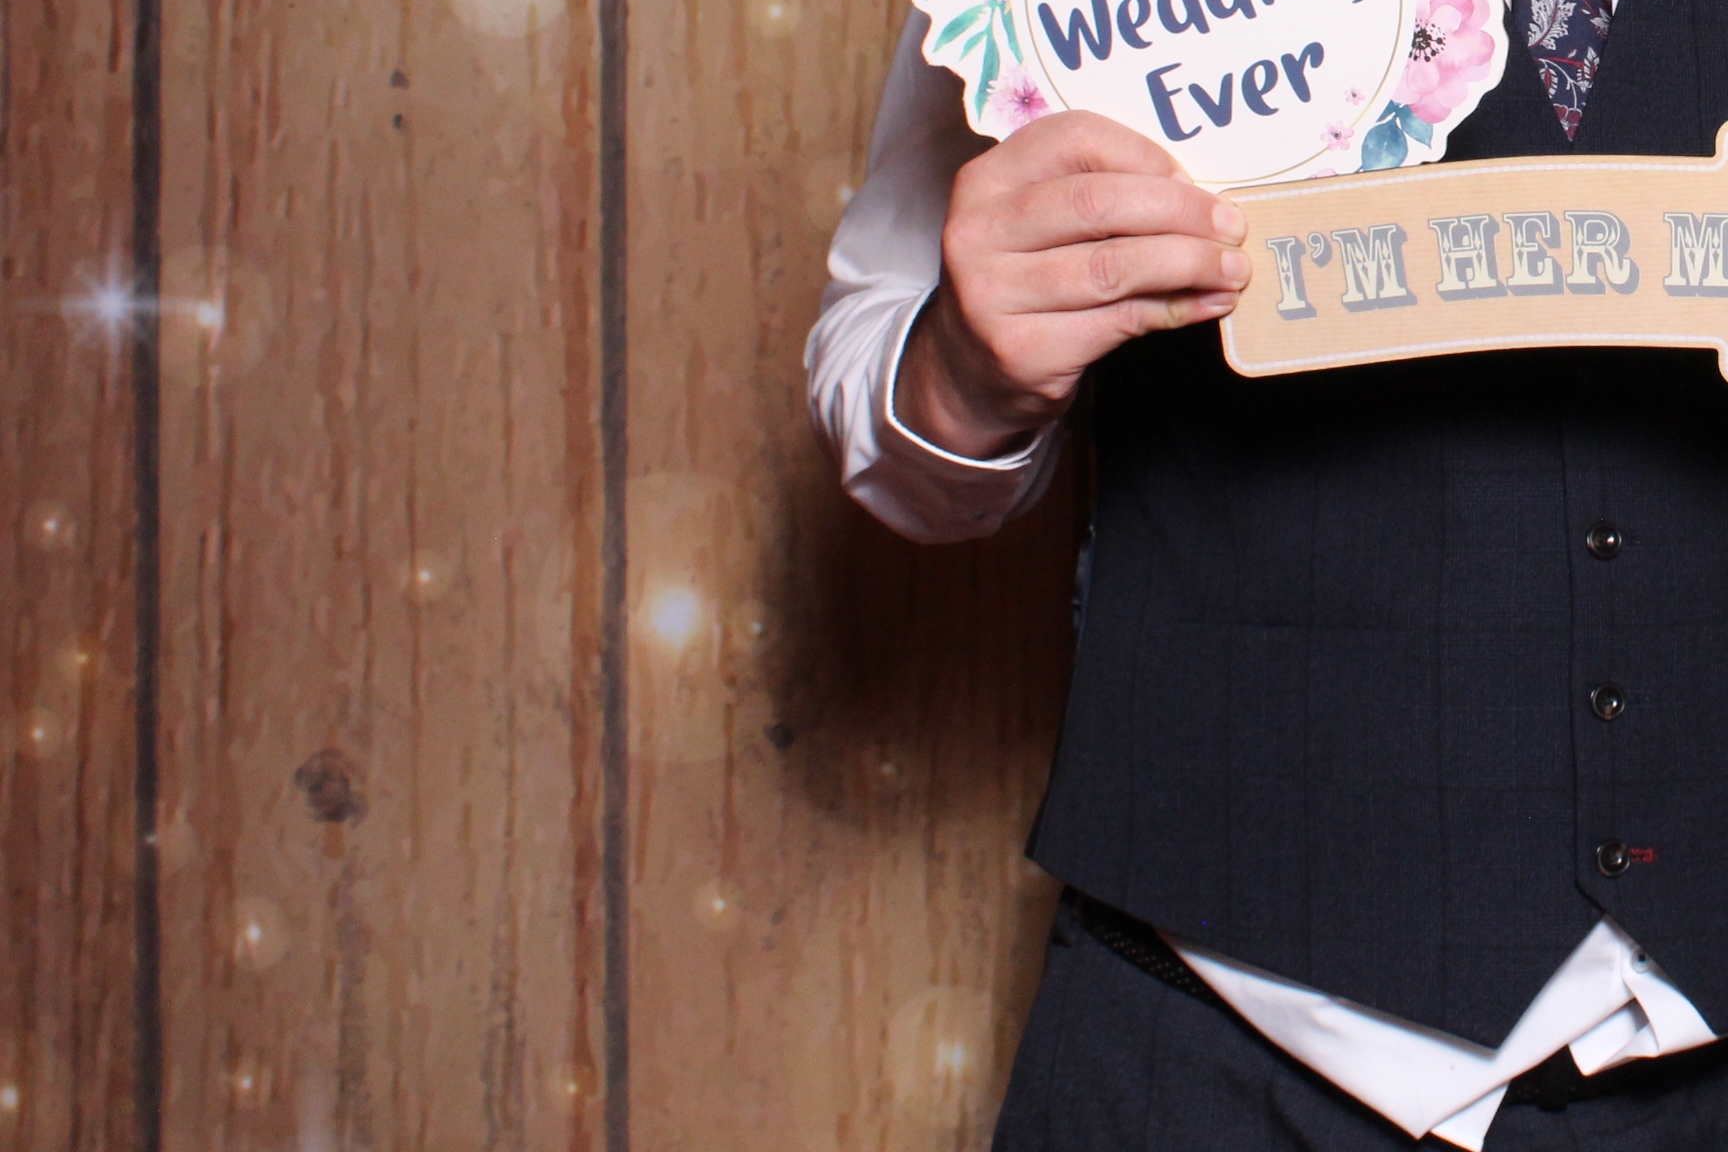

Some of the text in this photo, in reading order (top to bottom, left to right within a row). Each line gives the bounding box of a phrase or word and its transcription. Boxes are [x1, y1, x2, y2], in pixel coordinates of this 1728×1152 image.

[1145, 41, 1325, 142] Ever
[1265, 222, 1418, 320] I'M
[1427, 209, 1640, 300] HER
